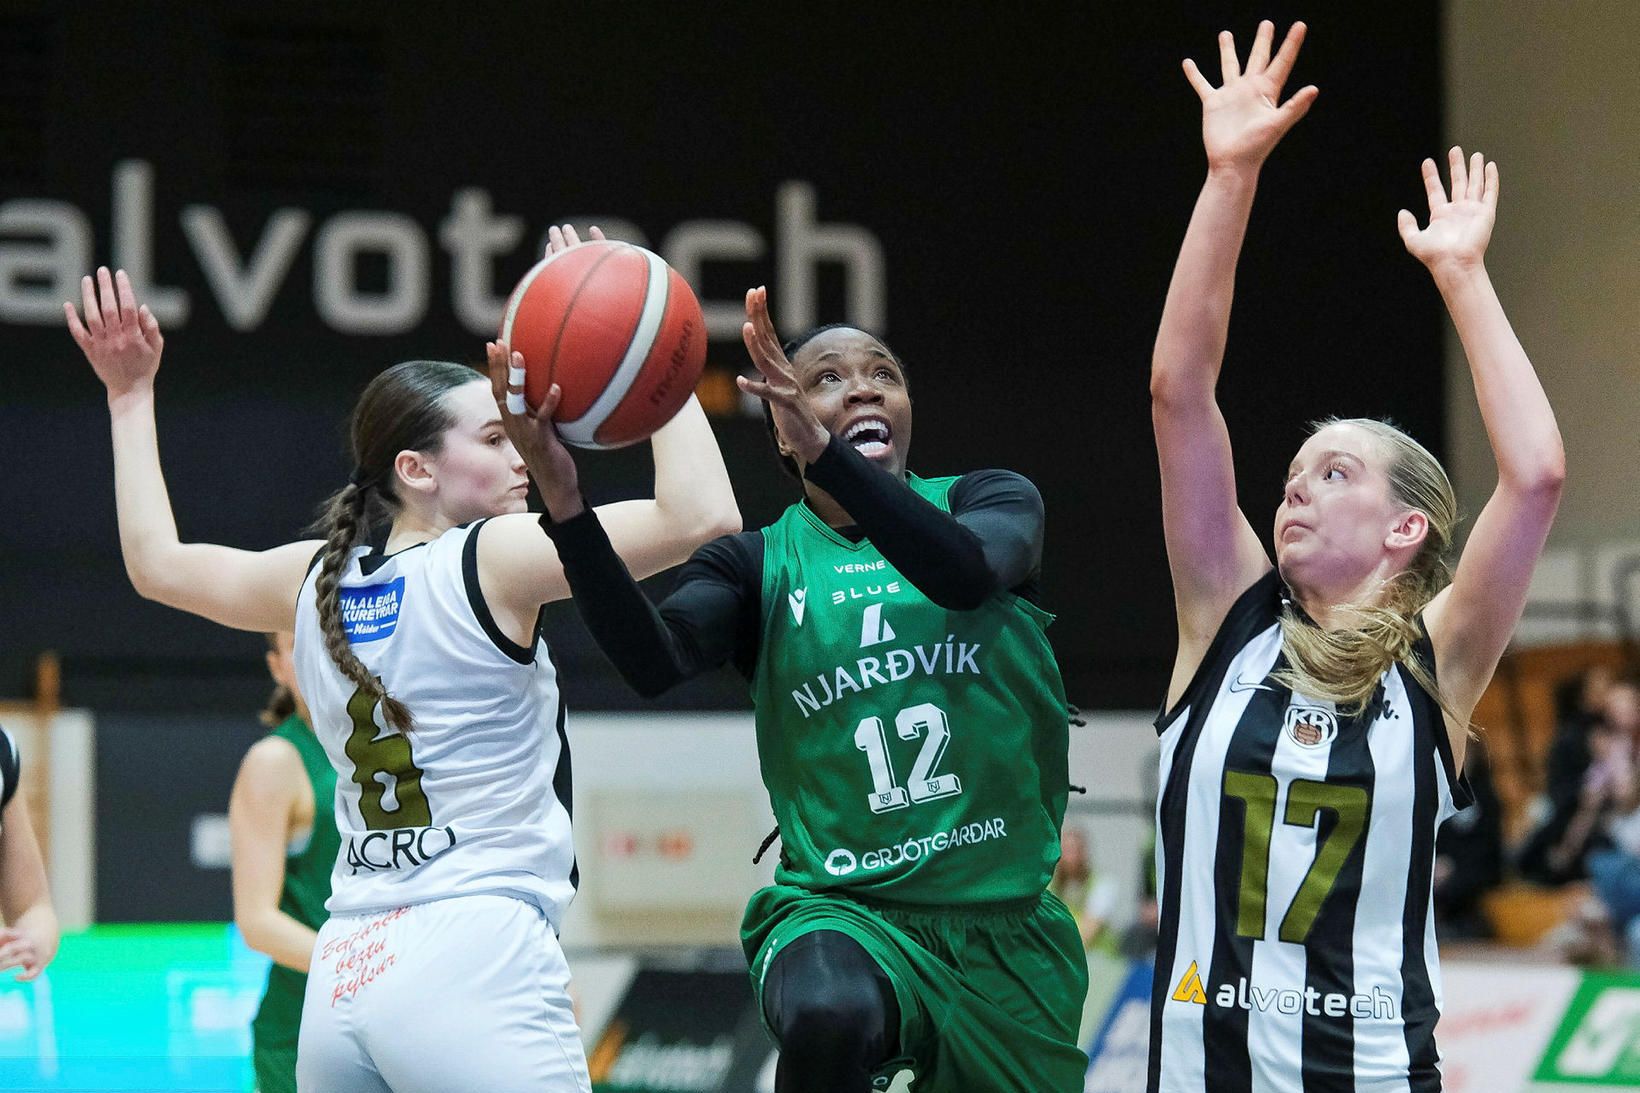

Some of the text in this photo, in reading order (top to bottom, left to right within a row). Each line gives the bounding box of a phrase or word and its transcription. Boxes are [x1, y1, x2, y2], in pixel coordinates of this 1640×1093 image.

[0, 159, 887, 335] alvotch
[651, 320, 693, 405] molten
[831, 581, 901, 605] BLUE
[833, 559, 887, 574] VERNE
[791, 634, 981, 718] NJARÐVÍK
[345, 675, 432, 831] 6
[854, 702, 963, 814] 12
[861, 817, 1008, 870] GRJÓTGARÐAR
[1223, 769, 1371, 944] 17
[1215, 977, 1396, 1020] alvotech
